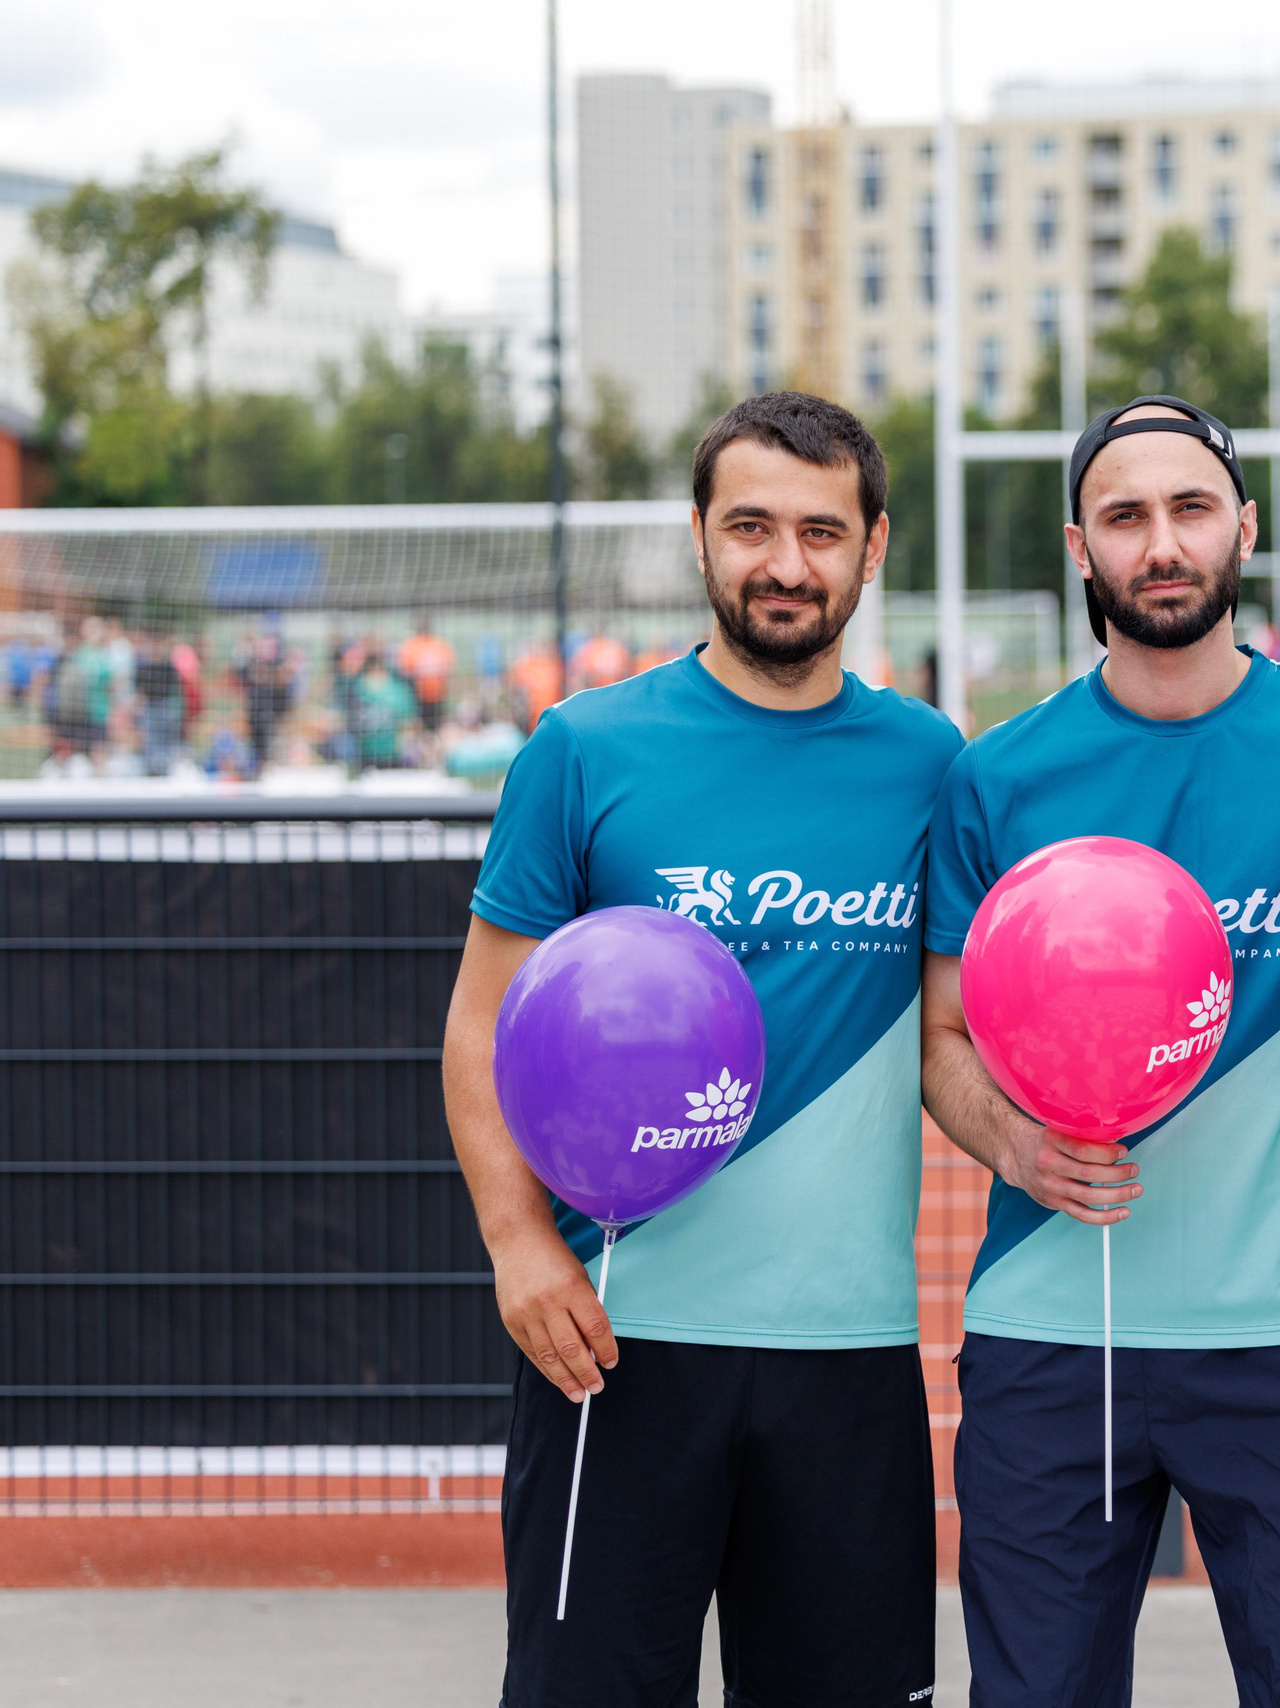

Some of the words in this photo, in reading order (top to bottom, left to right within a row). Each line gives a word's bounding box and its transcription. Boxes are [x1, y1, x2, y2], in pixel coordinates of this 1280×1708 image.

[747, 869, 919, 929] Poetti
[761, 941, 770, 951] &
[783, 940, 819, 951] TEA
[831, 940, 908, 954] COMPANY
[1145, 1009, 1231, 1073] parma
